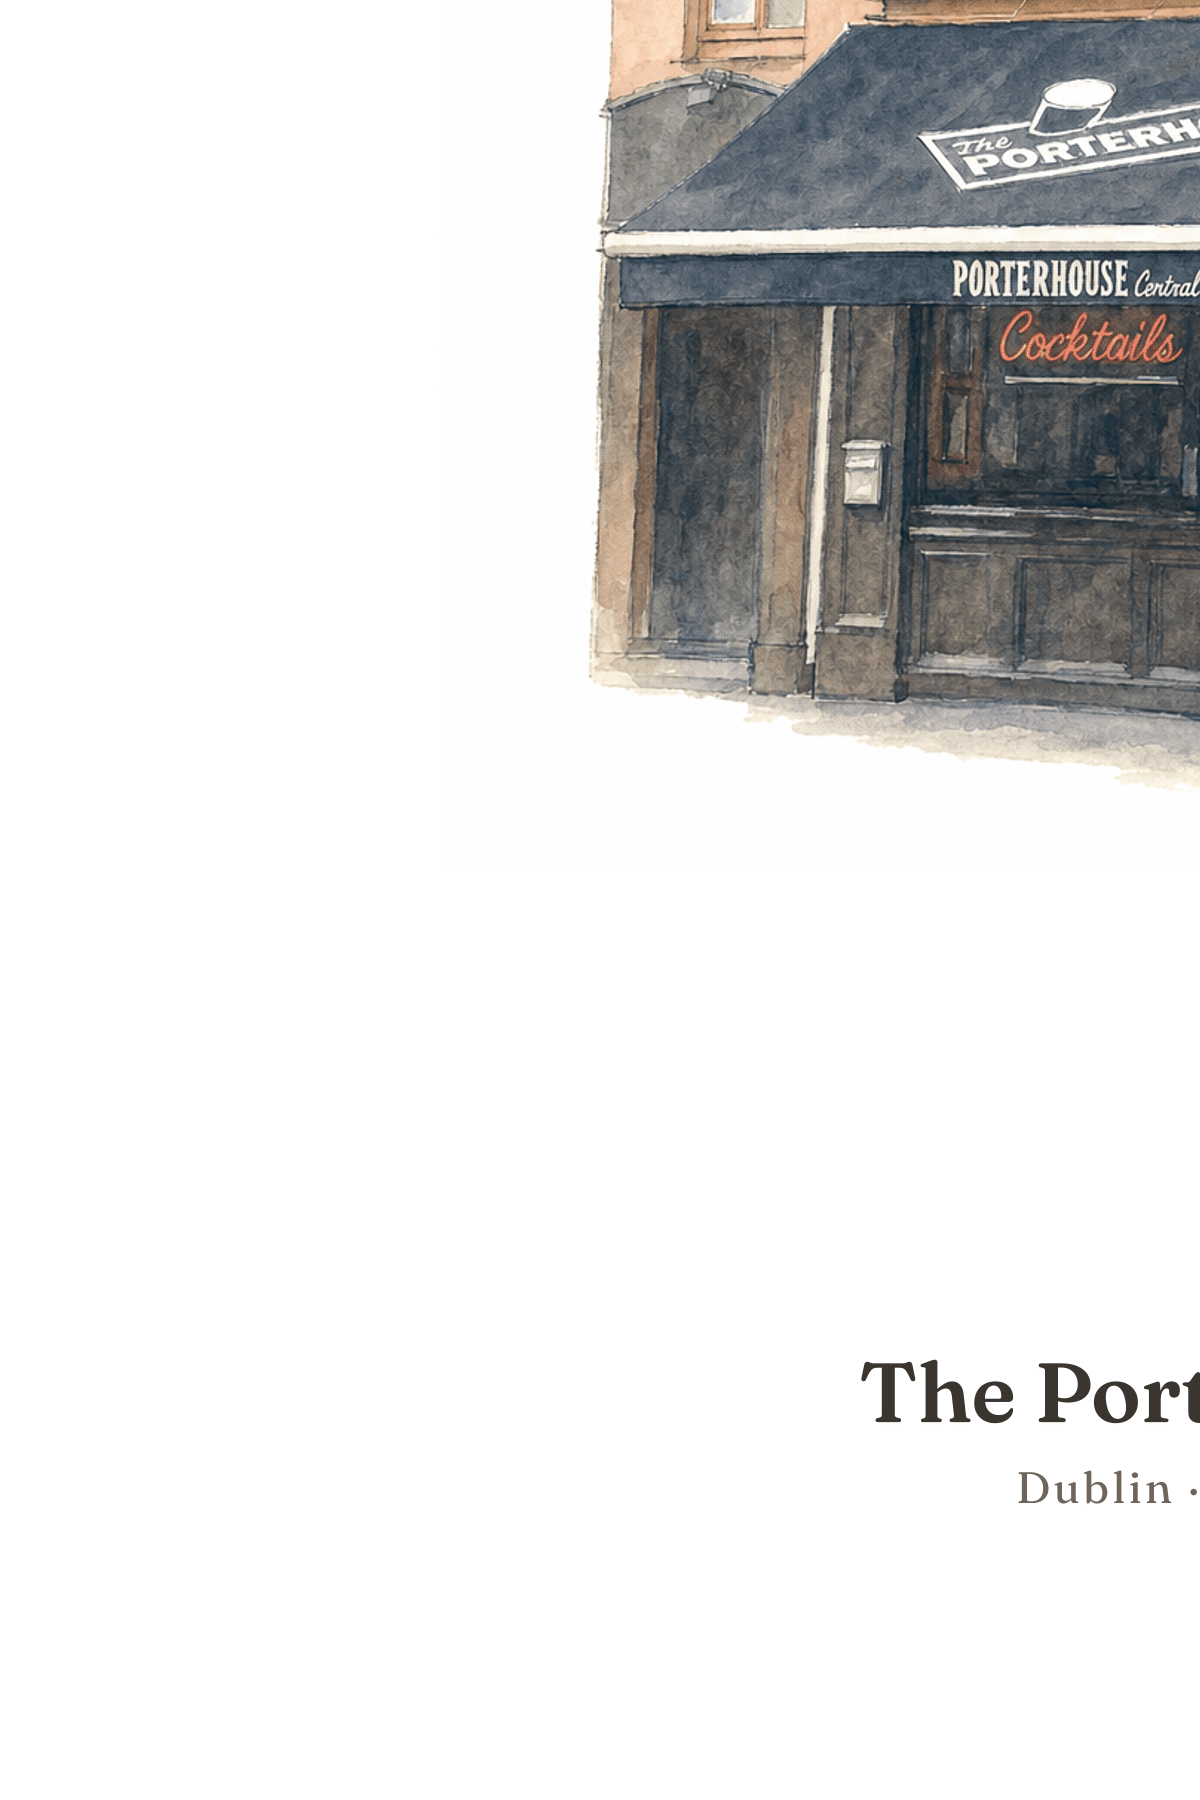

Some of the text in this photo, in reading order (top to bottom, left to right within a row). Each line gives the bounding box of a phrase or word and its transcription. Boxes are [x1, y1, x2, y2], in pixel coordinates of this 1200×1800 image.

[951, 133, 1013, 155] The
[952, 259, 1129, 297] PORTERHOUSE
[1000, 310, 1183, 363] Cocktails
